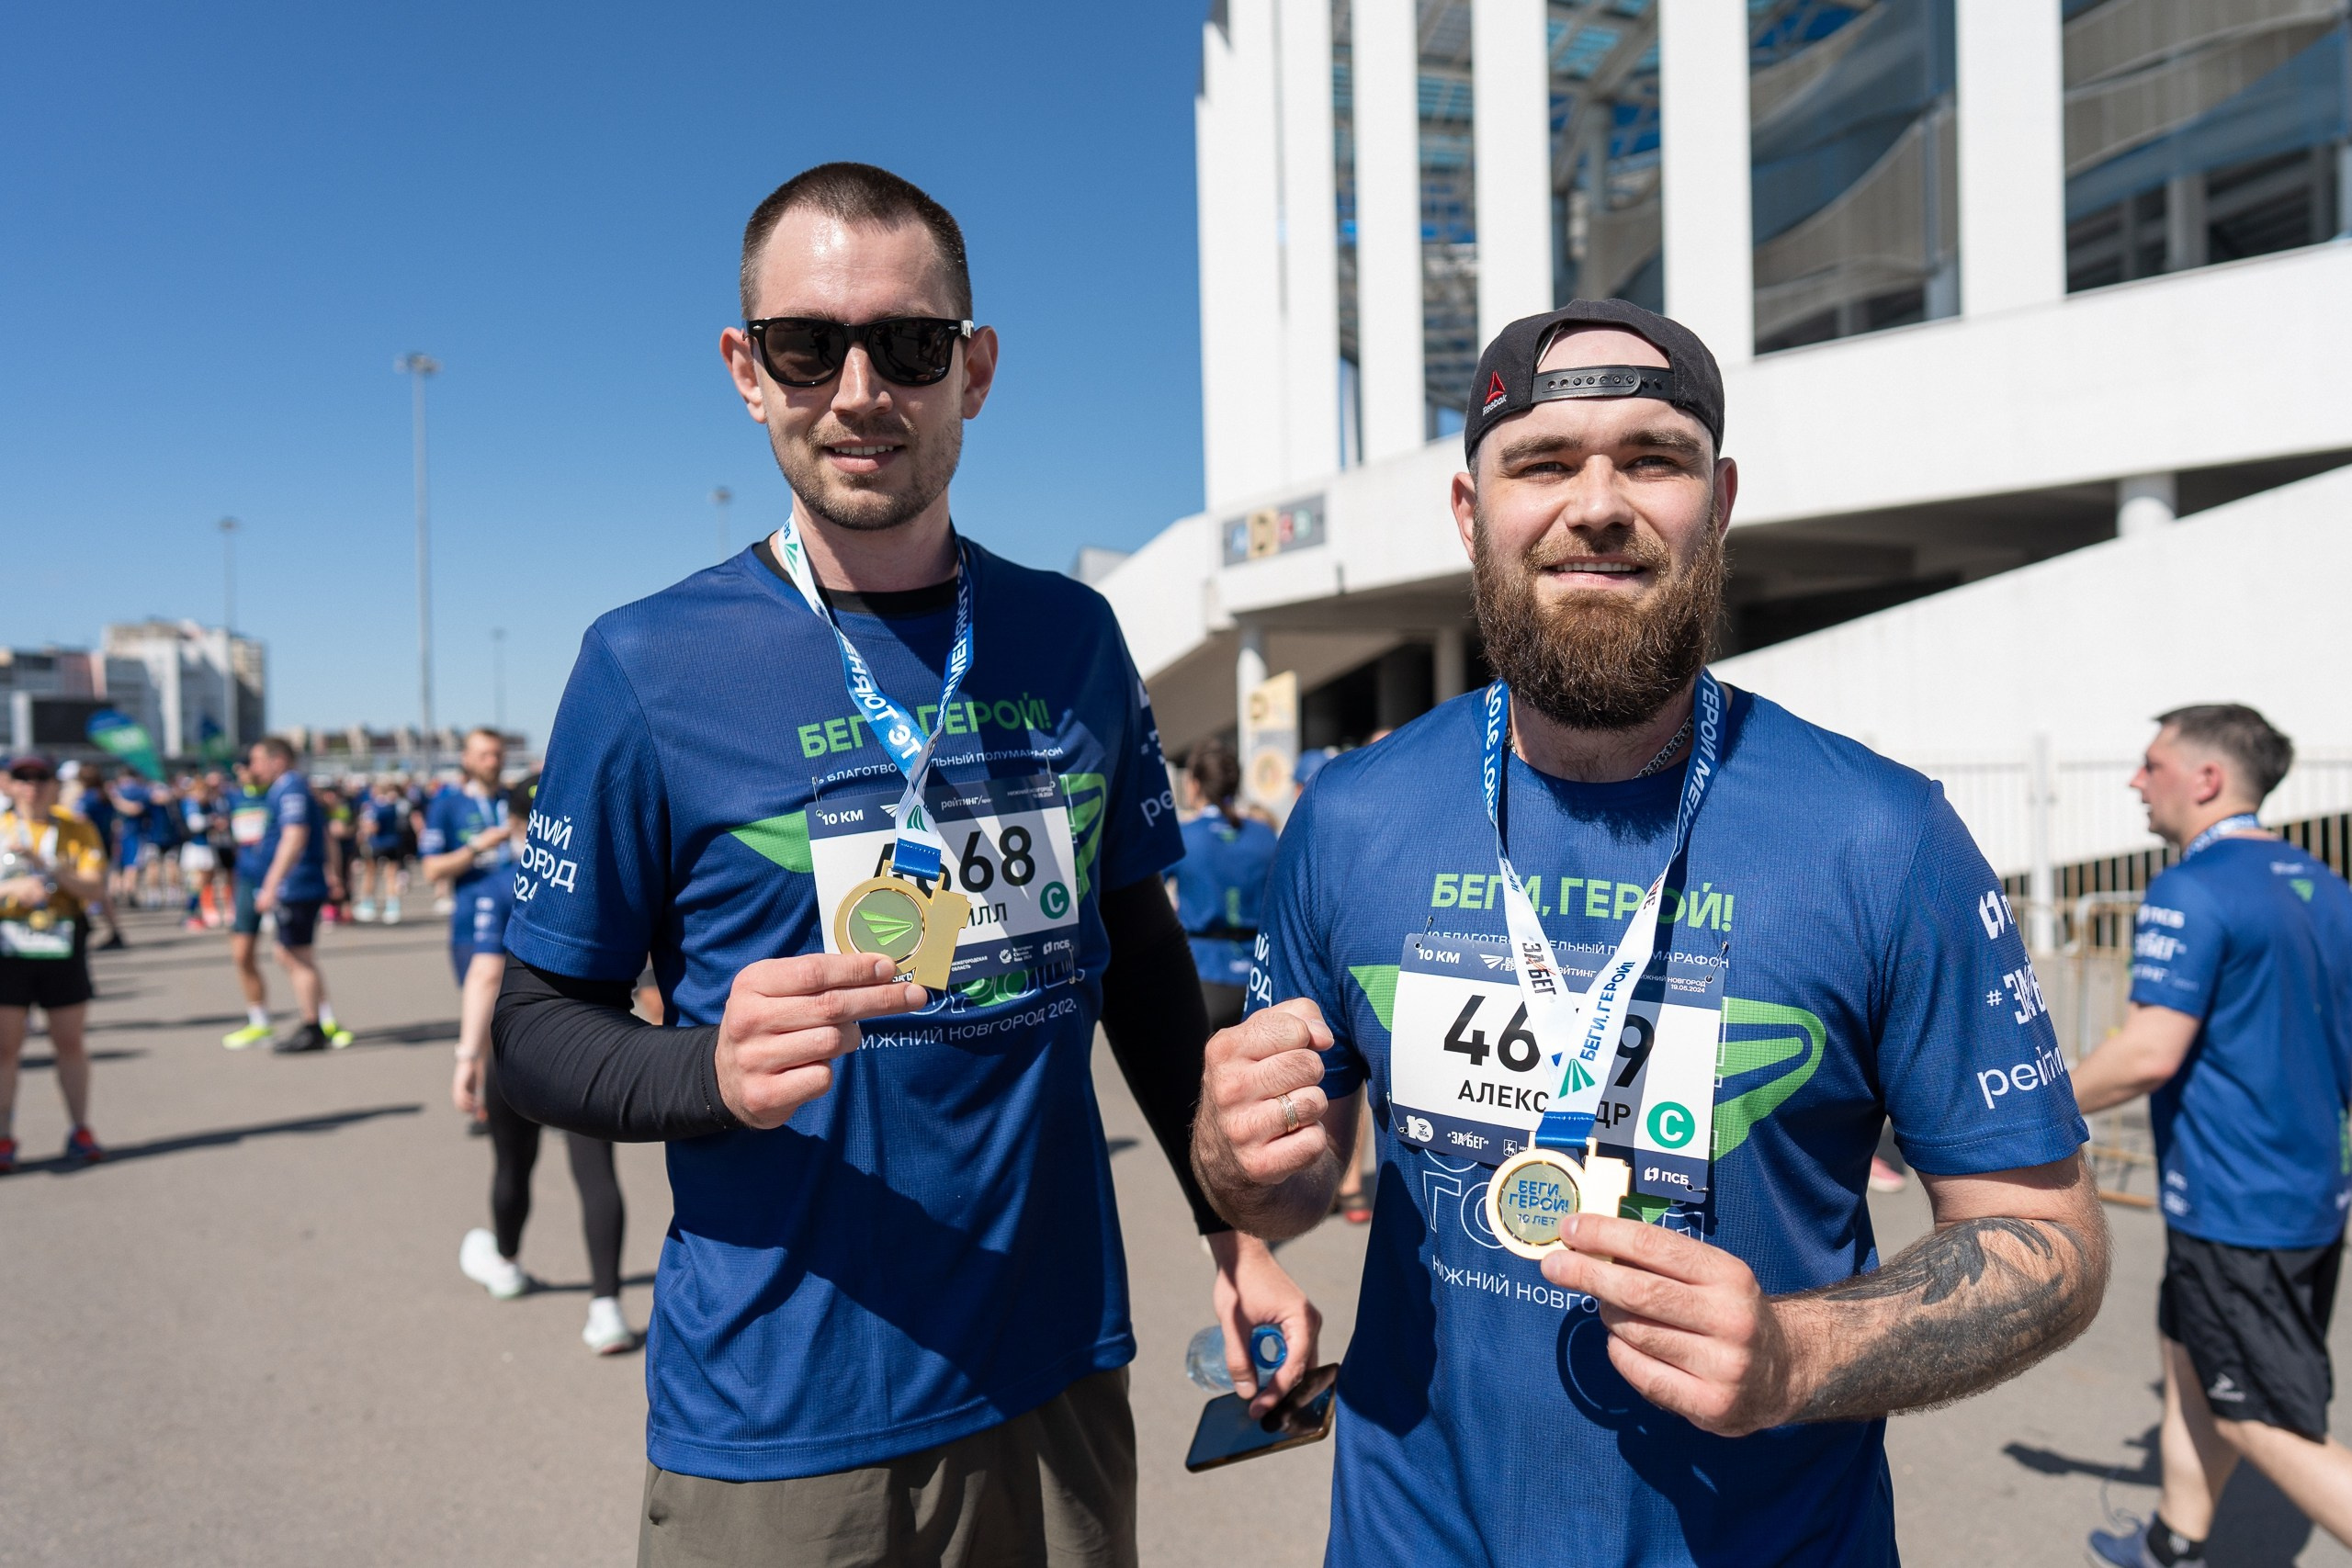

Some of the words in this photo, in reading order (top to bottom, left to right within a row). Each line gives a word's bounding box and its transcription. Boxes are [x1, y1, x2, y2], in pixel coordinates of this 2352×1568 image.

[1482, 394, 1507, 416] Reebok
[797, 715, 867, 759] БЕГ
[916, 692, 1053, 737] ГЕРОЙ!
[1486, 683, 1502, 750] ЭТОТ
[1700, 675, 1720, 762] ГЕРОИ
[821, 814, 838, 825] 10
[840, 809, 864, 825] КМ
[1430, 873, 1551, 917] БЕГИ,
[1559, 877, 1735, 932] ГЕРОЙ!
[967, 903, 1008, 927] ИЛЛ
[1053, 939, 1070, 951] ПСБ
[1419, 949, 1433, 961] 10
[1435, 950, 1460, 964] КМ
[1640, 974, 1666, 982] ИЖНИЙ
[1668, 976, 1706, 987] НОВГОРОД
[1670, 984, 1705, 993] 19.05.2024
[1580, 1015, 1610, 1061] БЕГИ,
[1597, 962, 1635, 1012] ГЕРОЙ!
[857, 1026, 943, 1050] ИЖНИЙ
[949, 1009, 1046, 1042] НОВГОРОД
[1443, 995, 1655, 1089] 469
[1457, 1079, 1631, 1128] АЛЕКСДР
[1518, 1179, 1562, 1198] БЕГИ,
[1661, 1170, 1690, 1185] ПСБ
[1509, 1193, 1569, 1213] ГЕРОЙ!
[1517, 1213, 1530, 1224] 10
[1532, 1215, 1557, 1226] ЛЕТ
[1432, 1255, 1510, 1297] НИЖНИЙ
[1516, 1282, 1599, 1313] НОВГО
